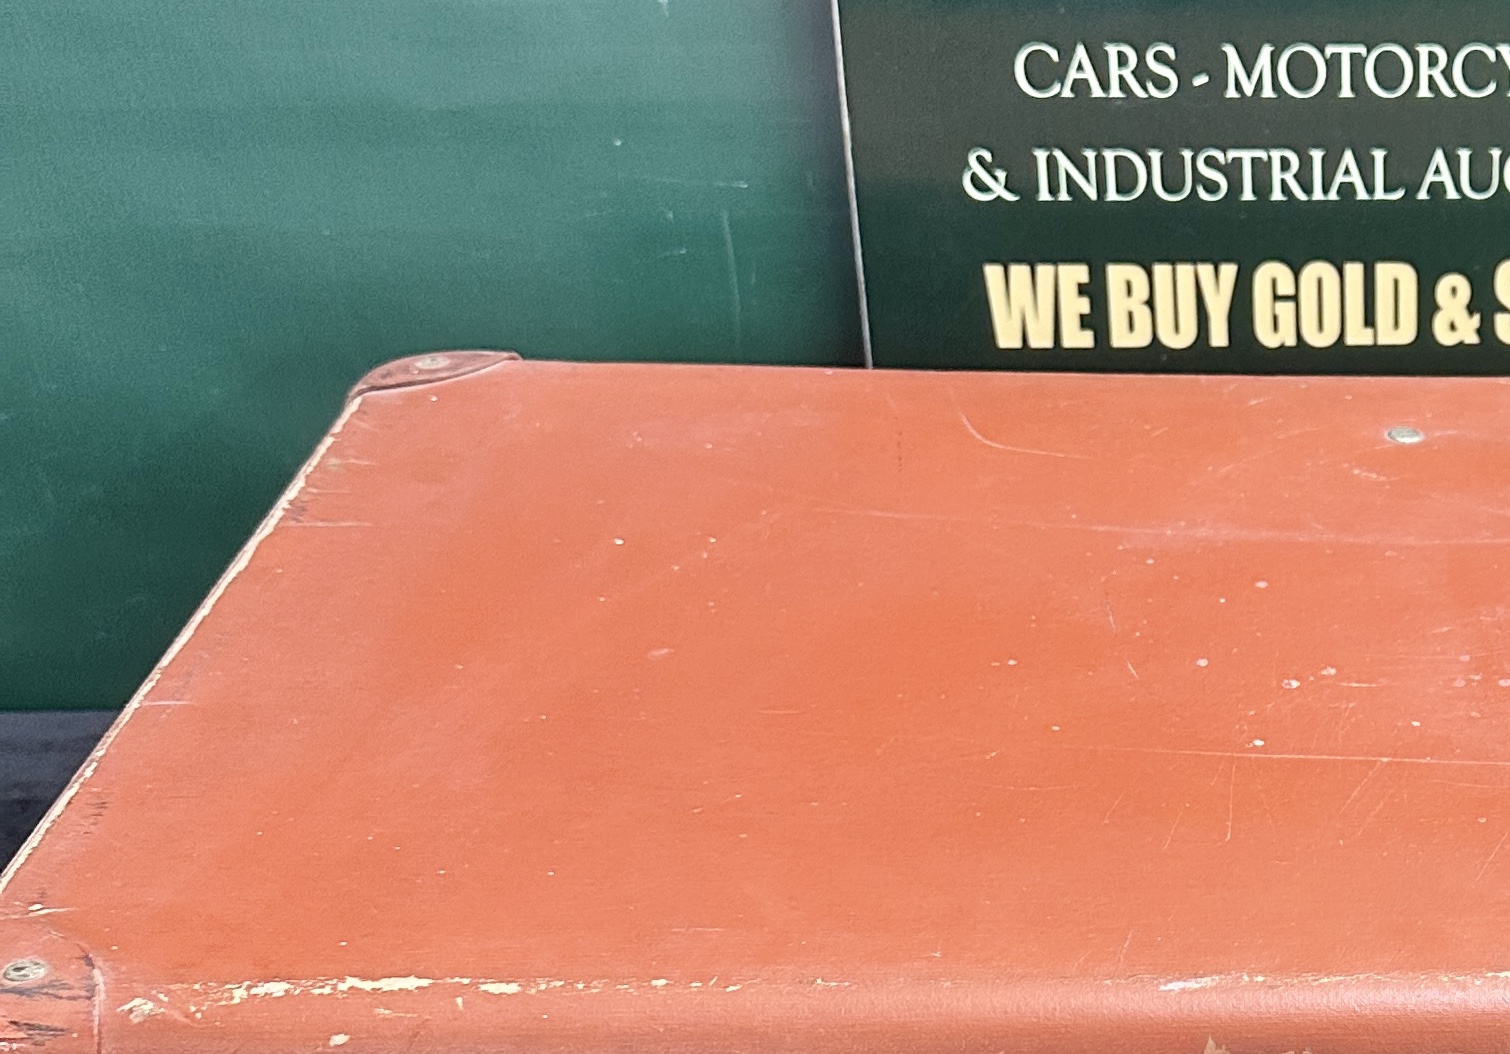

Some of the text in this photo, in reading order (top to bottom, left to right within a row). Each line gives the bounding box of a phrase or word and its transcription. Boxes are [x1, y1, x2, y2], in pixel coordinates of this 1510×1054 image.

[1013, 41, 1179, 100] CARS
[961, 147, 1020, 202] &
[1032, 147, 1407, 202] INDUSTRIAL
[982, 262, 1095, 350] WE
[1105, 261, 1240, 350] BUY
[1252, 259, 1419, 349] GOLD
[1431, 271, 1481, 347] &
